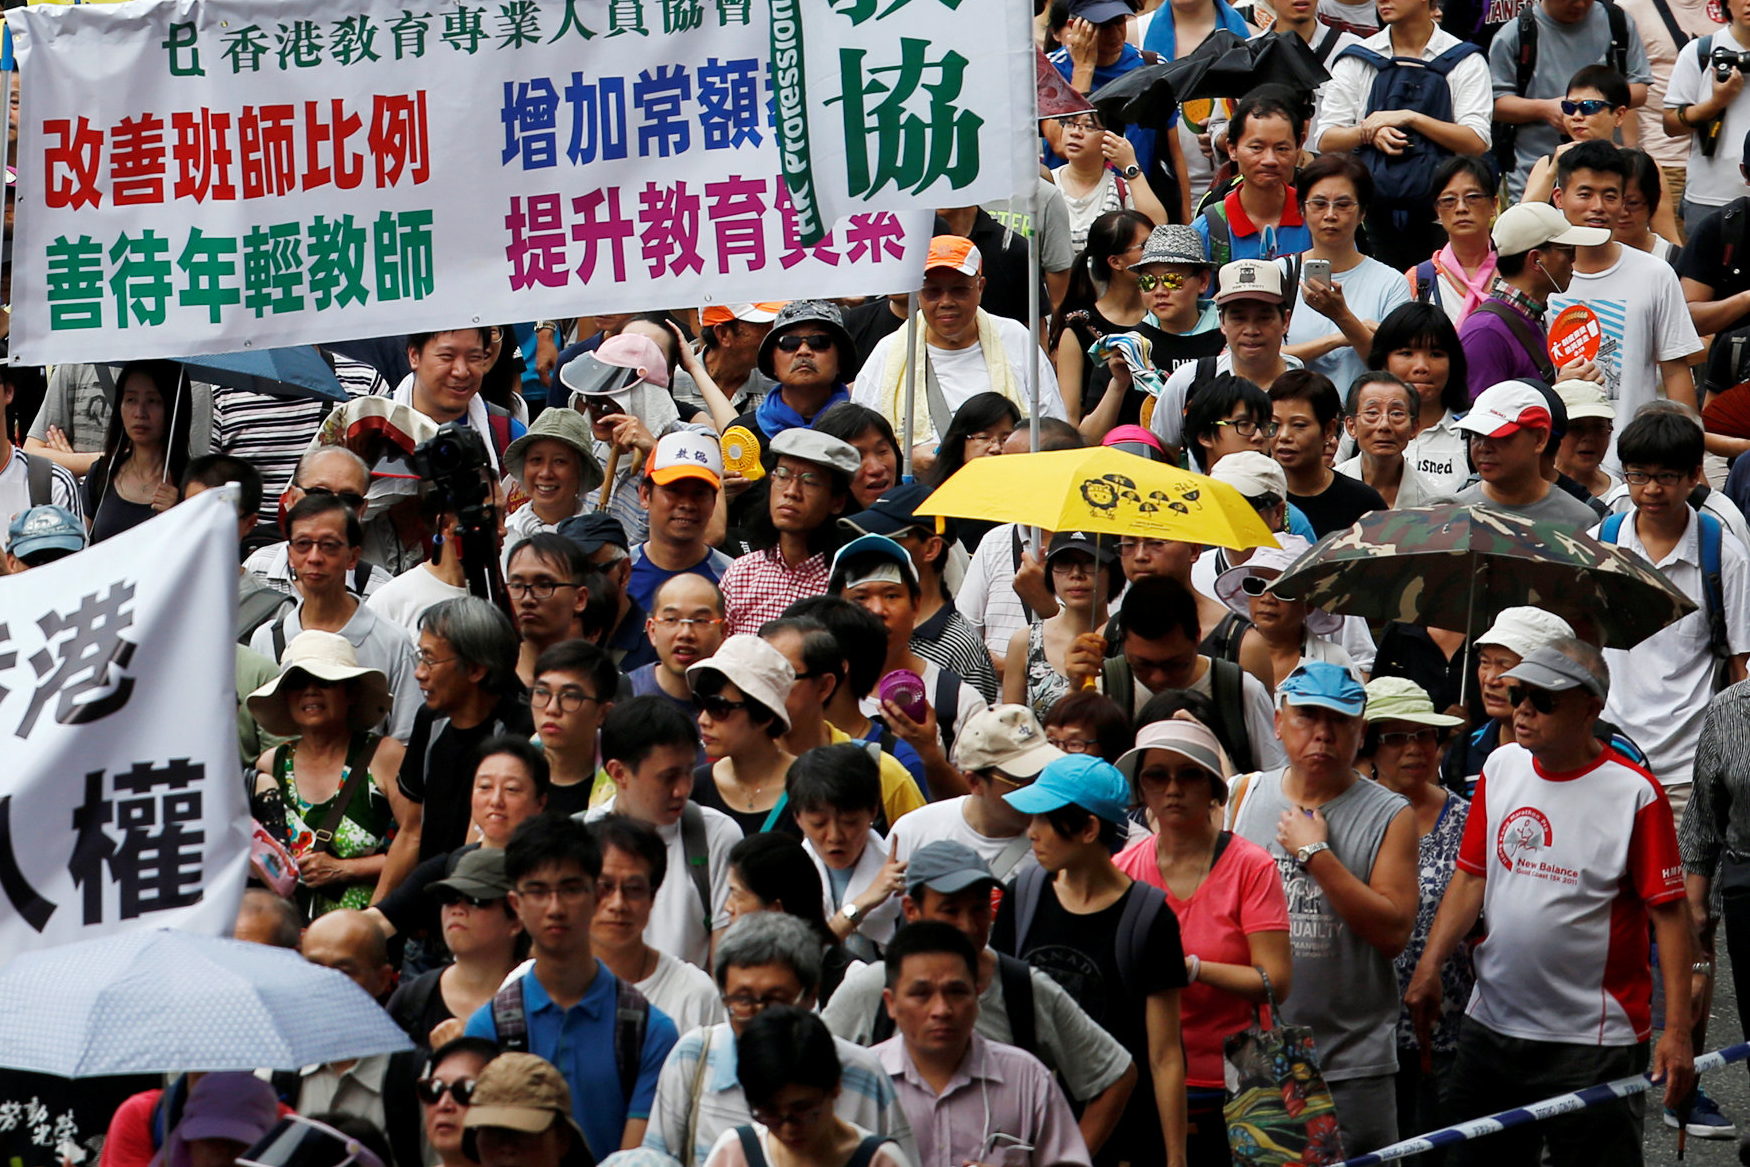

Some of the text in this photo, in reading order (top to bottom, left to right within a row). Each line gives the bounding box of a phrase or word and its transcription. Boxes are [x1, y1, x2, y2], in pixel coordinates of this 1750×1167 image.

[42, 55, 778, 213] 改善班師比例 增加常額
[46, 208, 435, 332] 善待年輕教師
[1539, 860, 1579, 878] Balance
